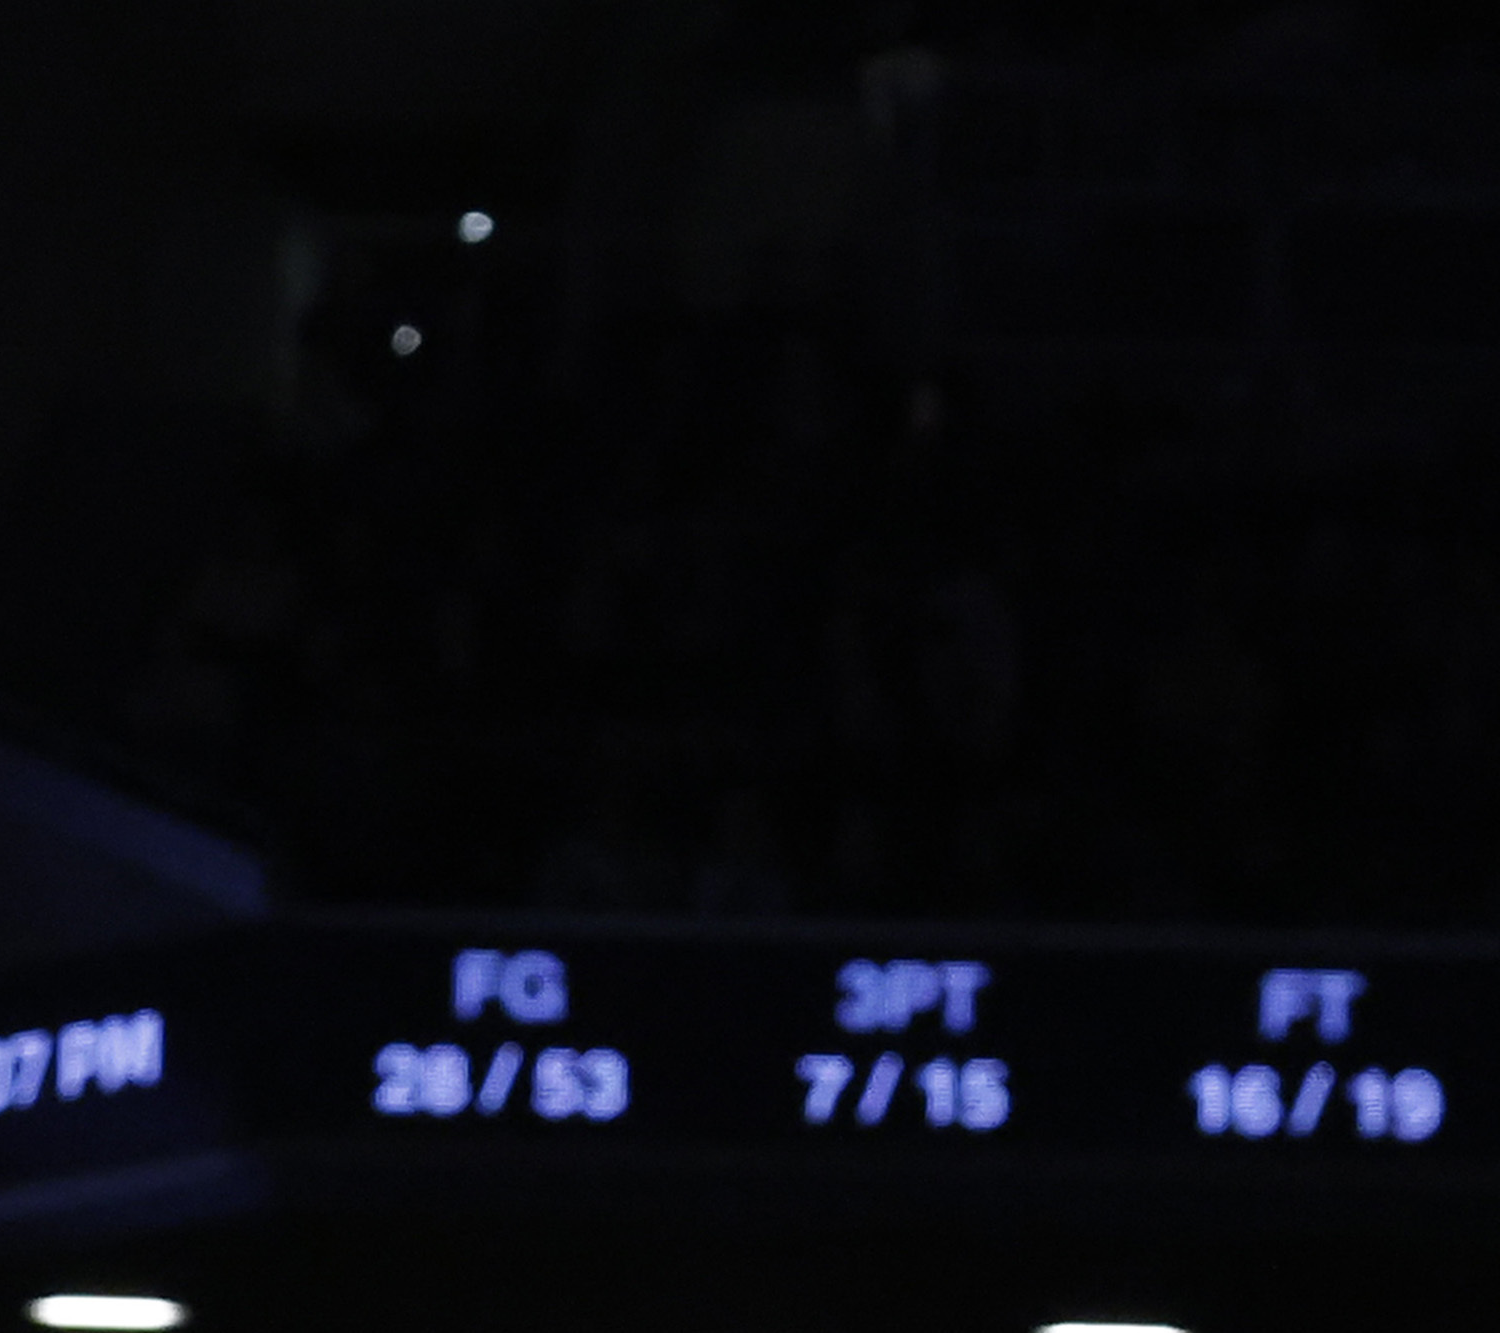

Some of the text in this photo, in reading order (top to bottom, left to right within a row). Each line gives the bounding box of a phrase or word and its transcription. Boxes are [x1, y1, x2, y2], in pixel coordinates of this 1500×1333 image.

[450, 947, 568, 1024] FG
[834, 957, 990, 1034] 3PT
[1257, 967, 1366, 1045] FT
